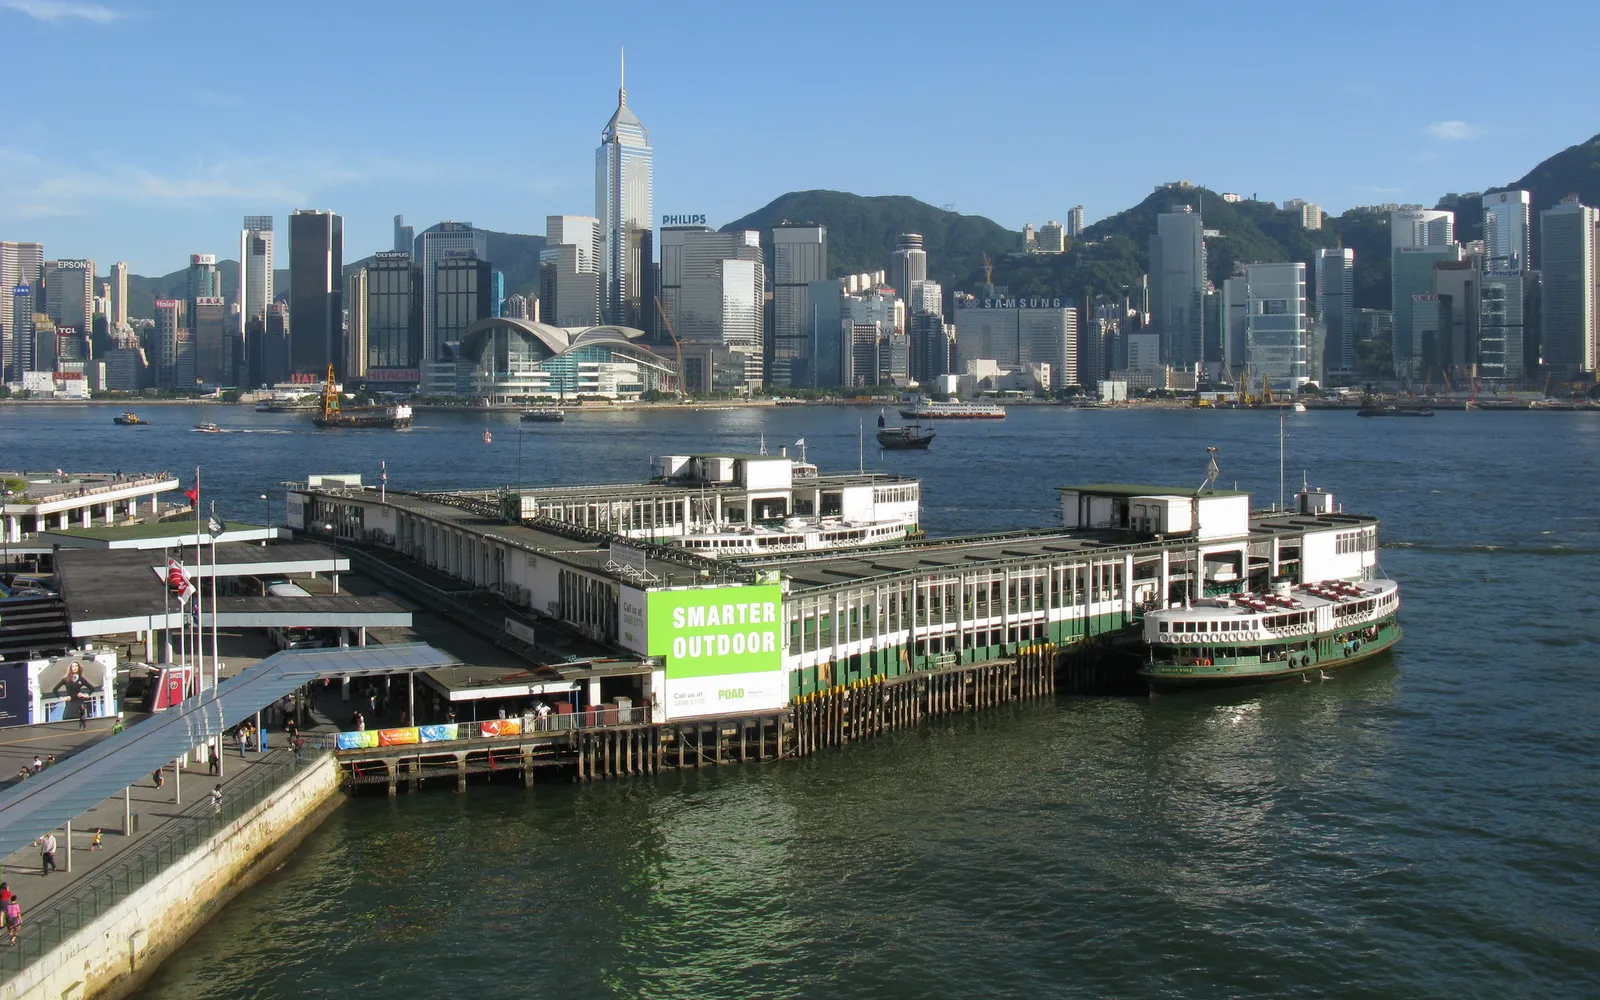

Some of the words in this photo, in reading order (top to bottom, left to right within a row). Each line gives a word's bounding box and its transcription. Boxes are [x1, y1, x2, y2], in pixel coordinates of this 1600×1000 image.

[662, 214, 707, 225] PHILIPS
[57, 260, 87, 269] EPSON
[1492, 270, 1520, 278] Principal
[156, 300, 175, 308] Haier
[984, 298, 1061, 309] SAMSUNG
[53, 372, 82, 380] MGM
[291, 373, 316, 384] ITAT
[366, 370, 419, 381] HITACHI
[624, 601, 632, 613] Call
[672, 602, 775, 629] SMARTER
[673, 631, 776, 659] OUTDOOR
[673, 692, 686, 700] Call
[718, 688, 744, 701] POAD
